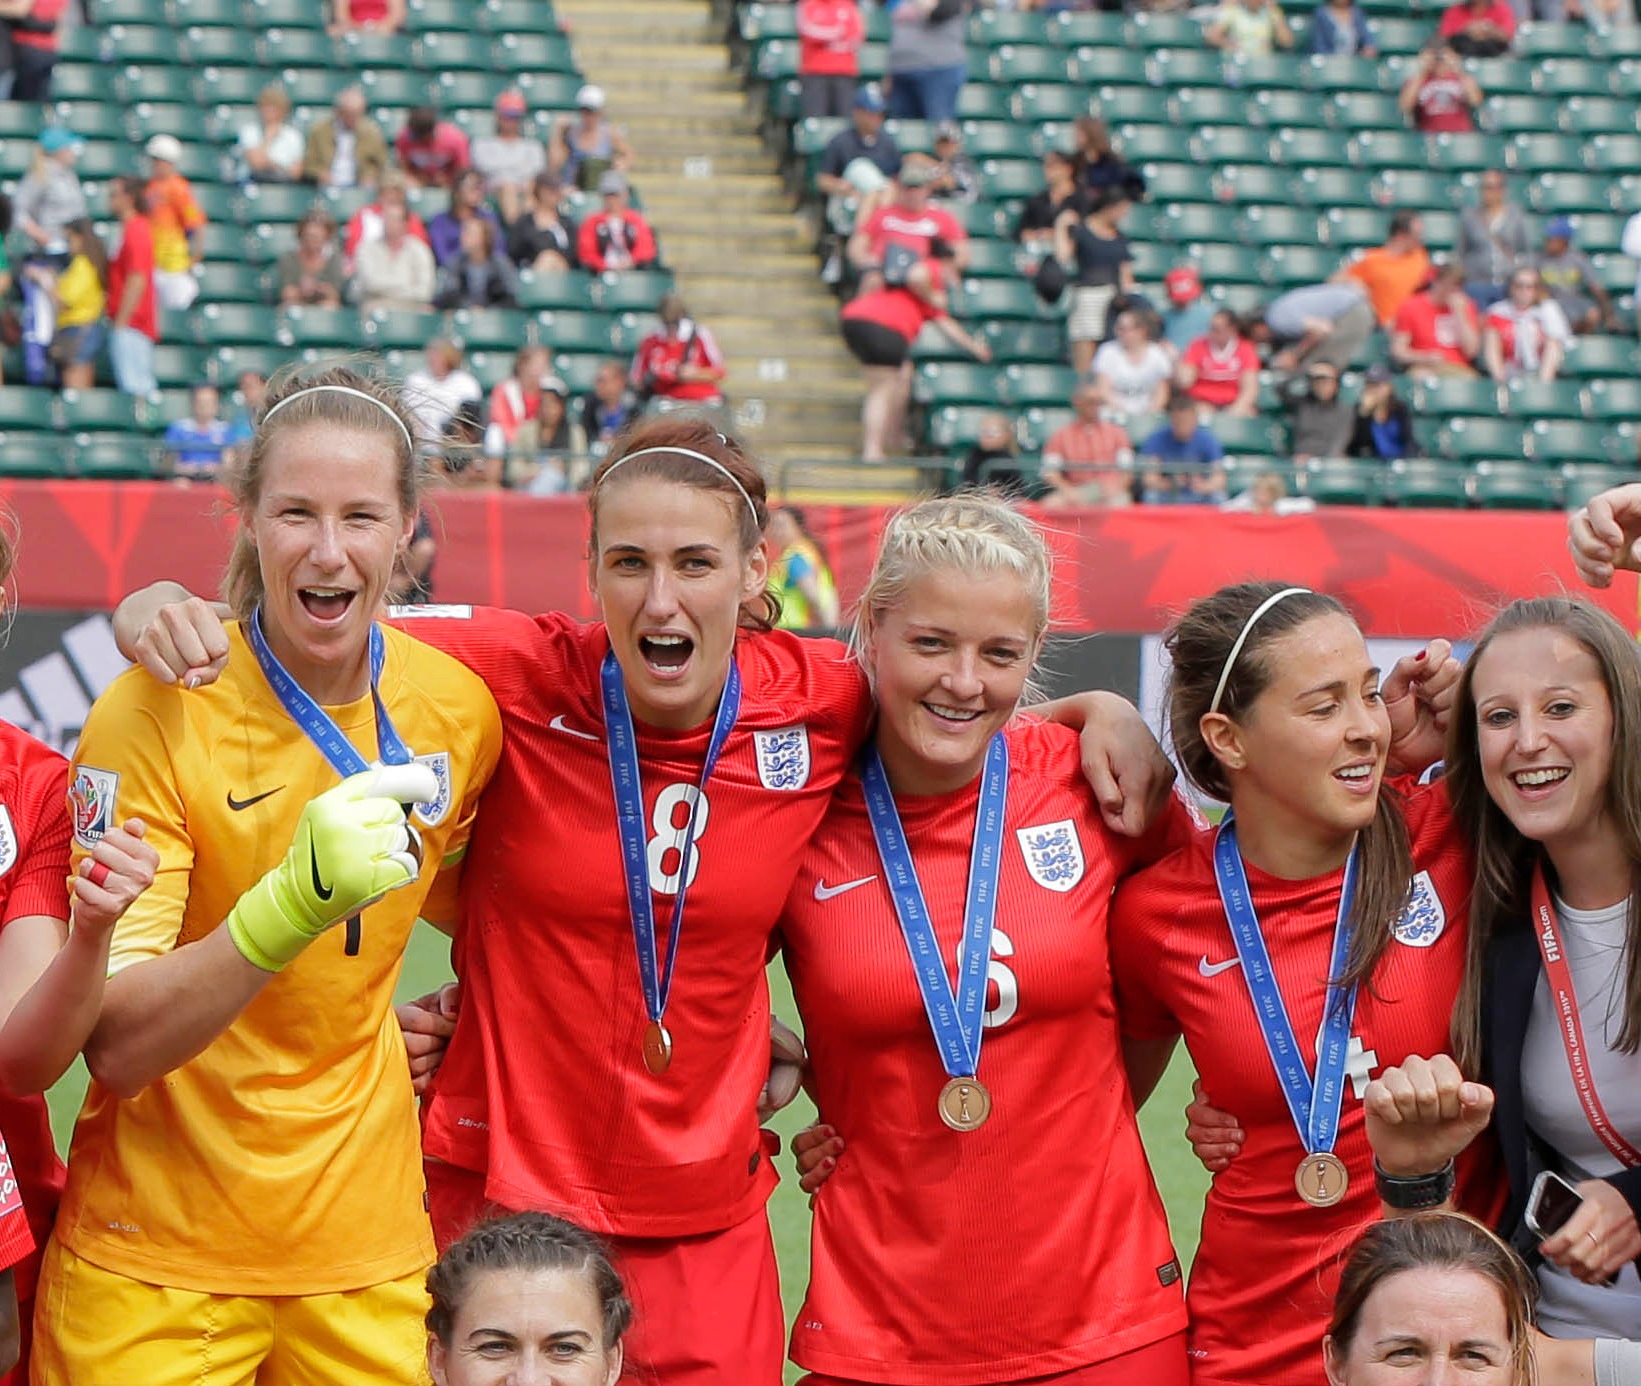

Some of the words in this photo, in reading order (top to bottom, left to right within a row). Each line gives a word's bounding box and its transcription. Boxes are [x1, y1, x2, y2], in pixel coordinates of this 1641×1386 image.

[615, 725, 625, 749] FIFA
[619, 762, 630, 787] FIFA
[990, 772, 1000, 796] FIFA
[623, 800, 637, 824] FIFA
[874, 794, 887, 815] FIFA
[986, 808, 996, 832] FIFA
[629, 837, 639, 861] FIFA
[646, 783, 709, 895] 8
[884, 828, 897, 850] FIFA
[981, 844, 994, 867] FIFA
[1223, 856, 1234, 877] FIFA
[894, 862, 909, 885] FIFA
[977, 879, 988, 902] FIFA
[1229, 889, 1243, 912] FIFA
[907, 898, 922, 920] FIFA
[974, 915, 984, 938] FIFA
[1240, 924, 1254, 947] FIFA
[917, 932, 931, 955] FIFA
[969, 950, 980, 975] FIFA
[1251, 960, 1265, 983] FIFA
[926, 968, 941, 991] FIFA
[957, 928, 1018, 1027] 6
[965, 987, 977, 1012] FIFA
[1262, 995, 1276, 1018] FIFA
[936, 1003, 950, 1027] FIFA
[1273, 1031, 1288, 1054] FIFA
[1328, 1040, 1339, 1065] FIFA
[1287, 1067, 1301, 1089] FIFA
[1324, 1078, 1334, 1103] FIFA
